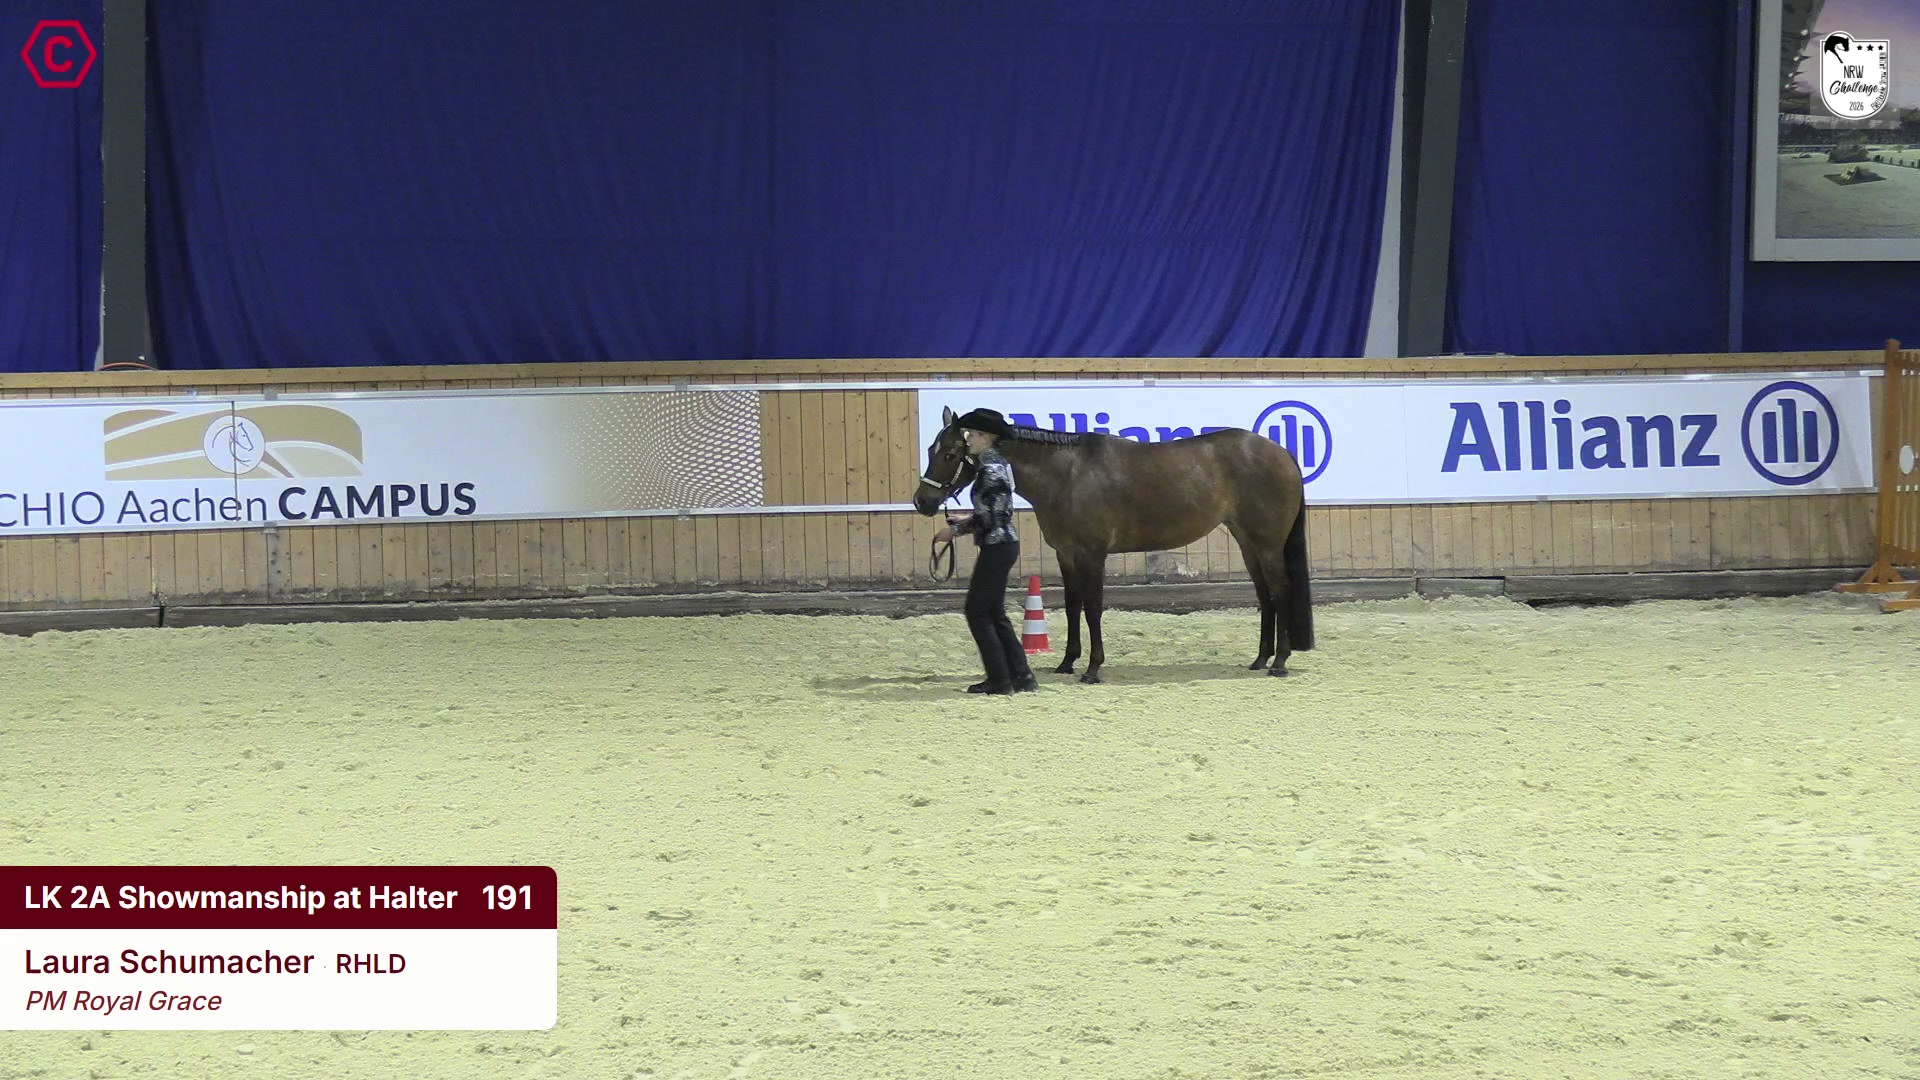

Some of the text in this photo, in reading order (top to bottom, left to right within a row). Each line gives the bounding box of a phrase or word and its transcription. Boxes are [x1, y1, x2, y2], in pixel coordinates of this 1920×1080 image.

[1440, 399, 1721, 473] Allianz
[0, 482, 477, 528] CHIO Aachen CAMPUS
